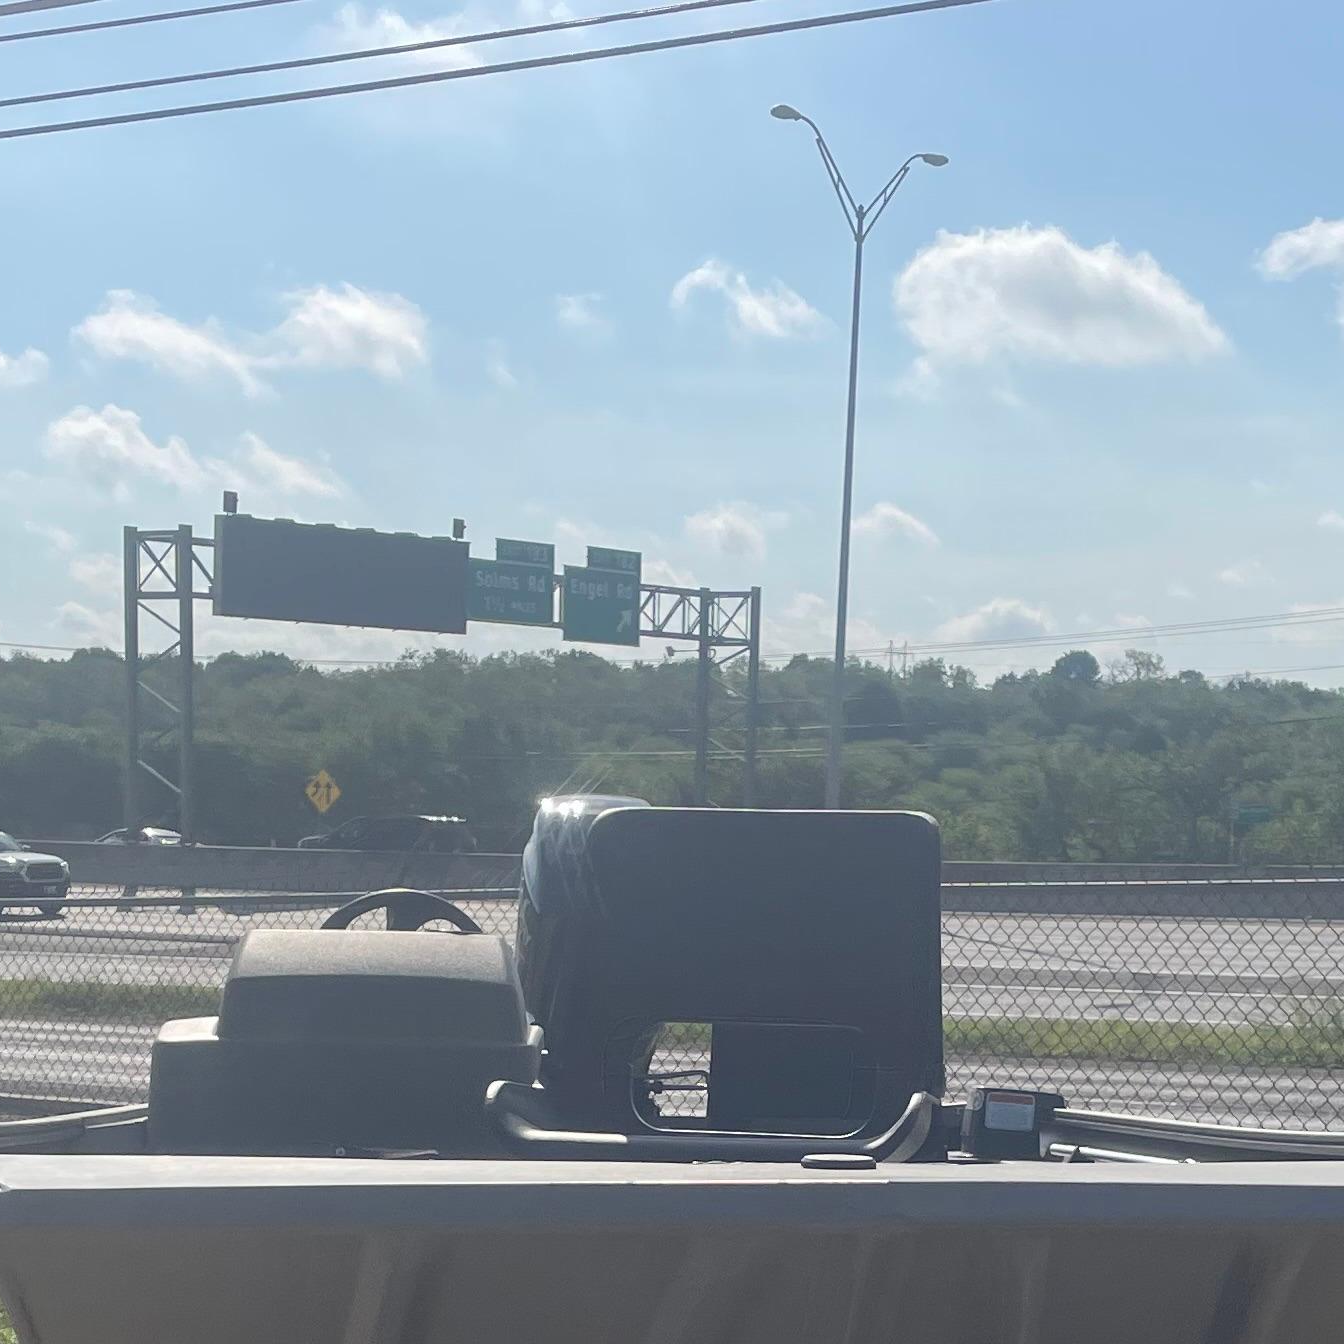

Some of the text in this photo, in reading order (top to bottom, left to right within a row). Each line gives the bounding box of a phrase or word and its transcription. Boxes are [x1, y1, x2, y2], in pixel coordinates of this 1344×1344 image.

[476, 570, 546, 593] Solms Rd
[570, 578, 634, 600] Engel Rd
